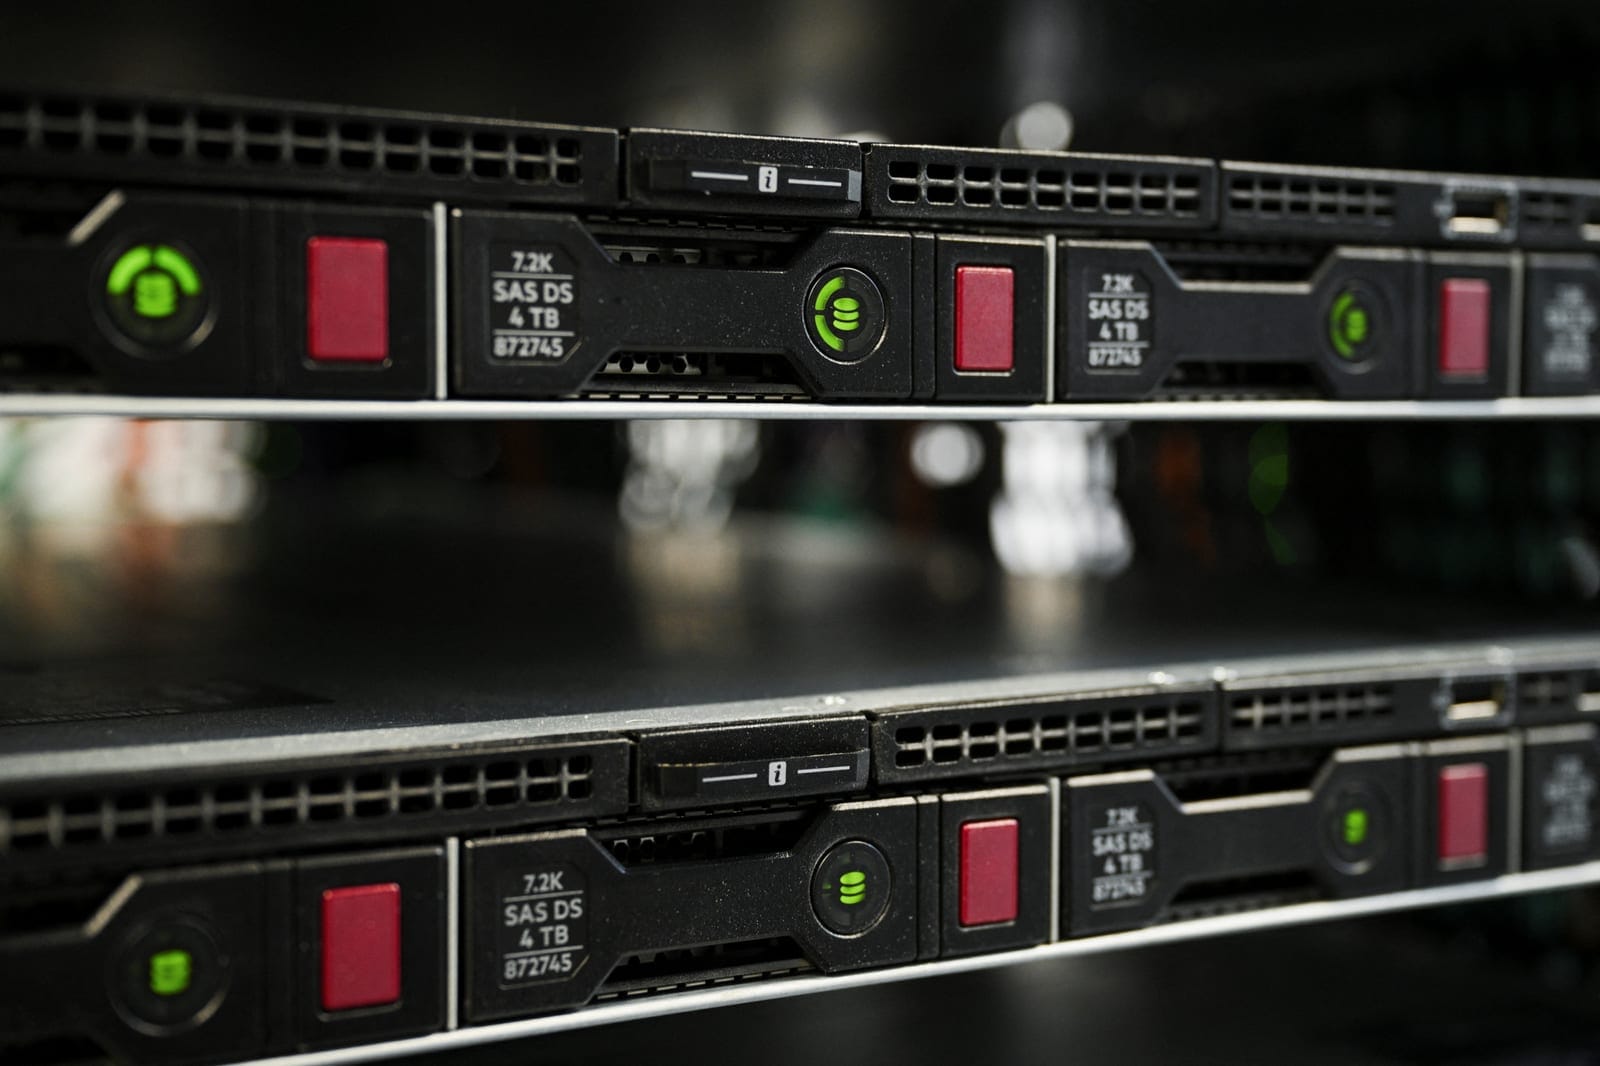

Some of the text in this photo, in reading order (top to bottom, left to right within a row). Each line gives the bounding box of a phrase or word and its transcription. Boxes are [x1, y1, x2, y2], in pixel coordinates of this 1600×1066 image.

[511, 251, 554, 272] 7.2K
[493, 280, 574, 304] SAS DS
[508, 306, 560, 329] 4 TB
[1088, 300, 1149, 320] SAS DS
[1099, 322, 1112, 340] 4
[493, 336, 564, 357] 872745
[523, 871, 564, 894] 7.2K
[504, 898, 583, 926] SAS DS
[519, 925, 569, 949] 4 TB
[504, 953, 573, 979] 872745
